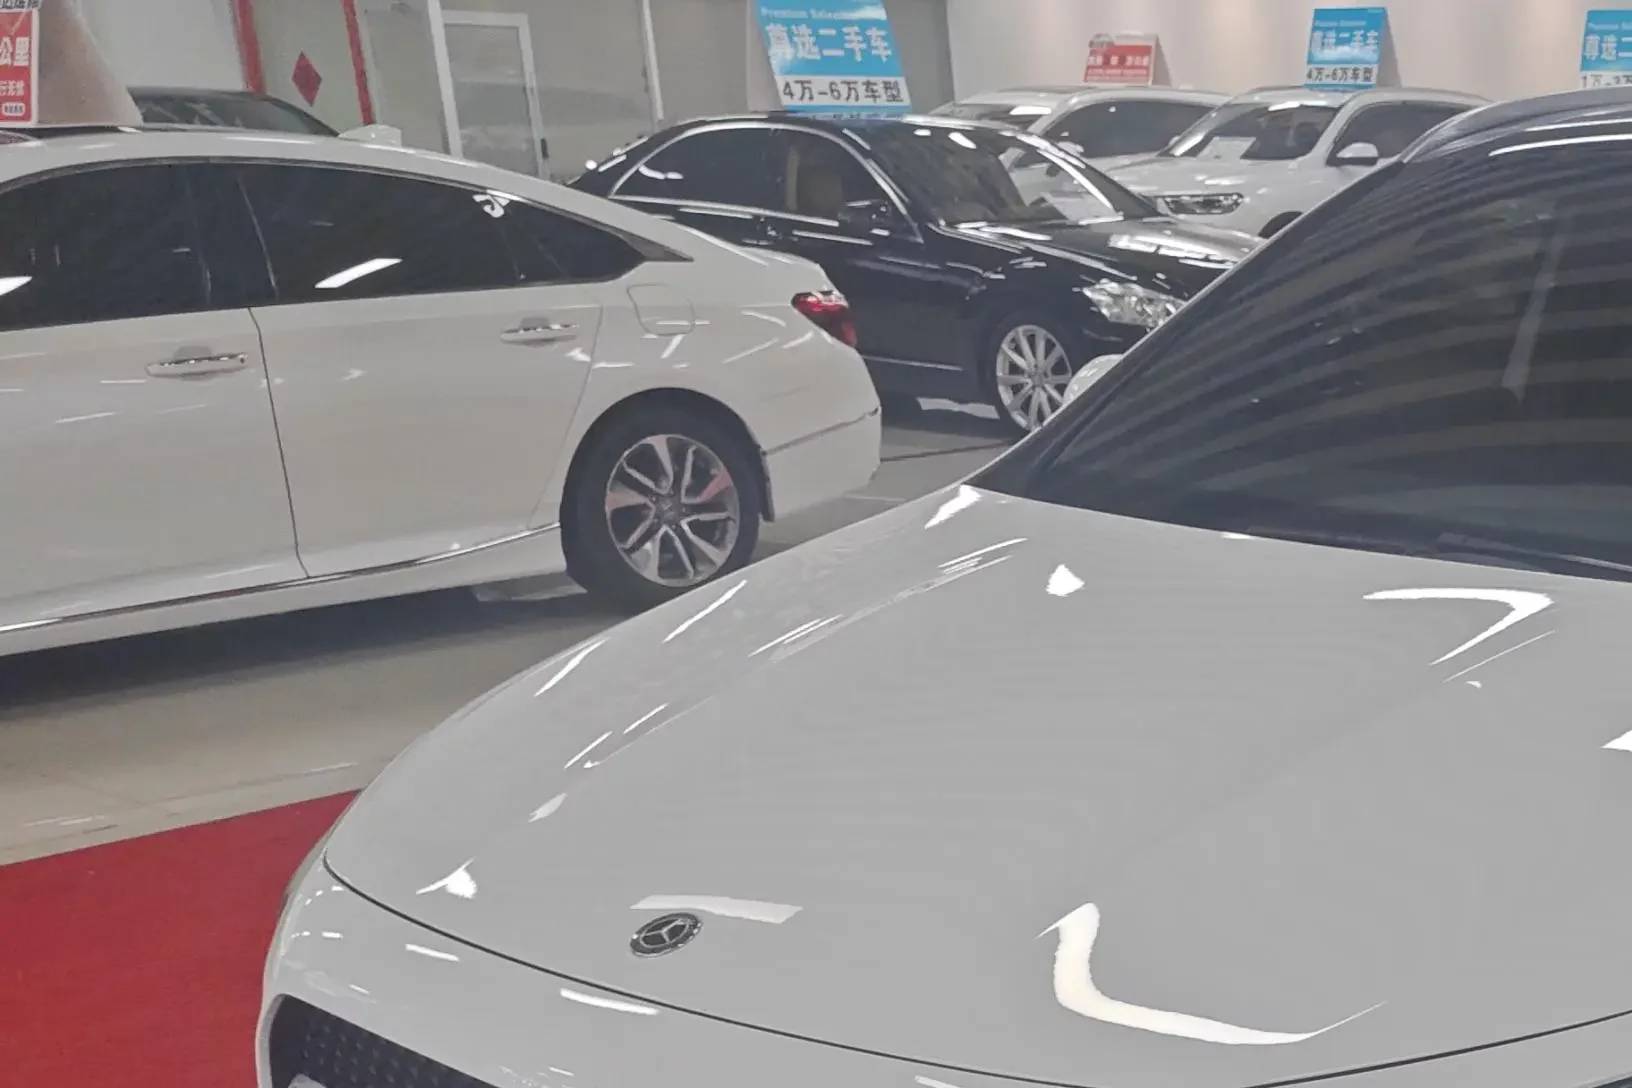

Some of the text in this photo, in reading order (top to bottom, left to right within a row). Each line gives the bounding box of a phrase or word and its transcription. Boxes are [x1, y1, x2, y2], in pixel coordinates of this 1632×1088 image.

[765, 23, 893, 62] 尊选二手车
[783, 79, 904, 102] 4万-6万车型
